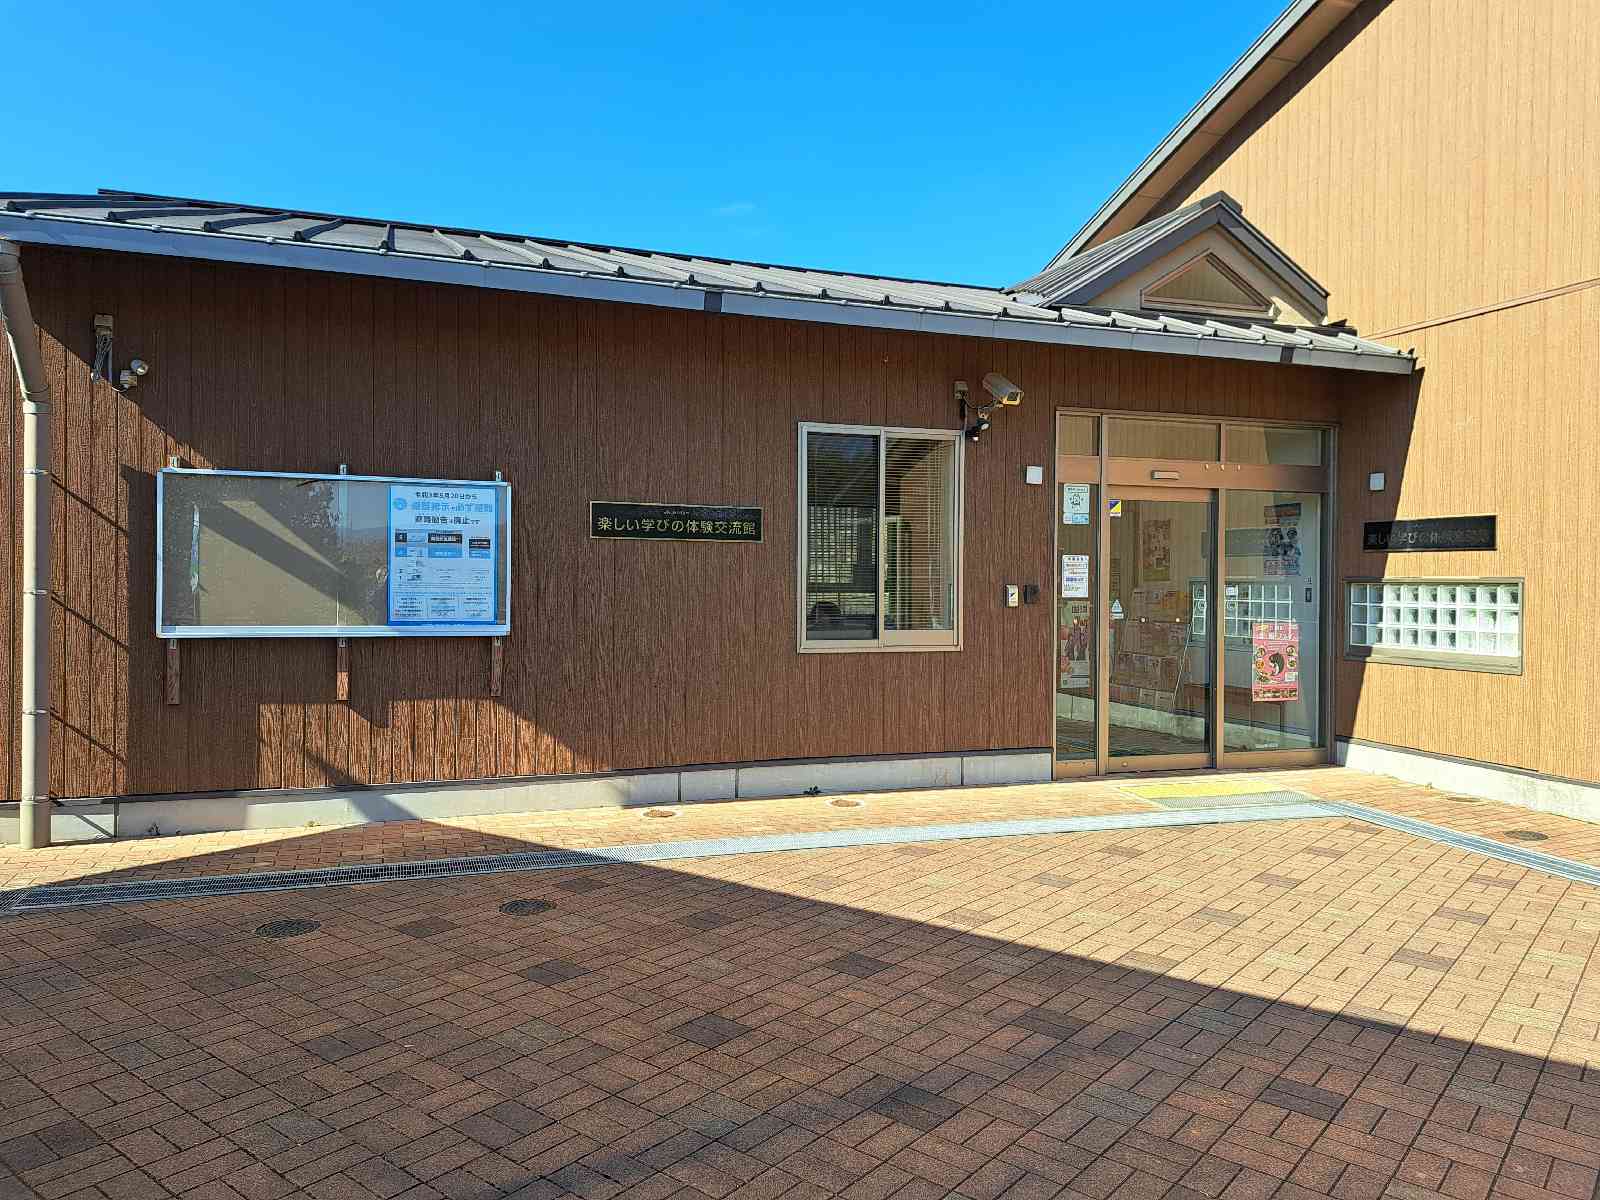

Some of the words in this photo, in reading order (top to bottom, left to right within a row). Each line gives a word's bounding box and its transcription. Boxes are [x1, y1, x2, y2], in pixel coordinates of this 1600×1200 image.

[597, 516, 756, 536] 楽しい学びの体験交流館
